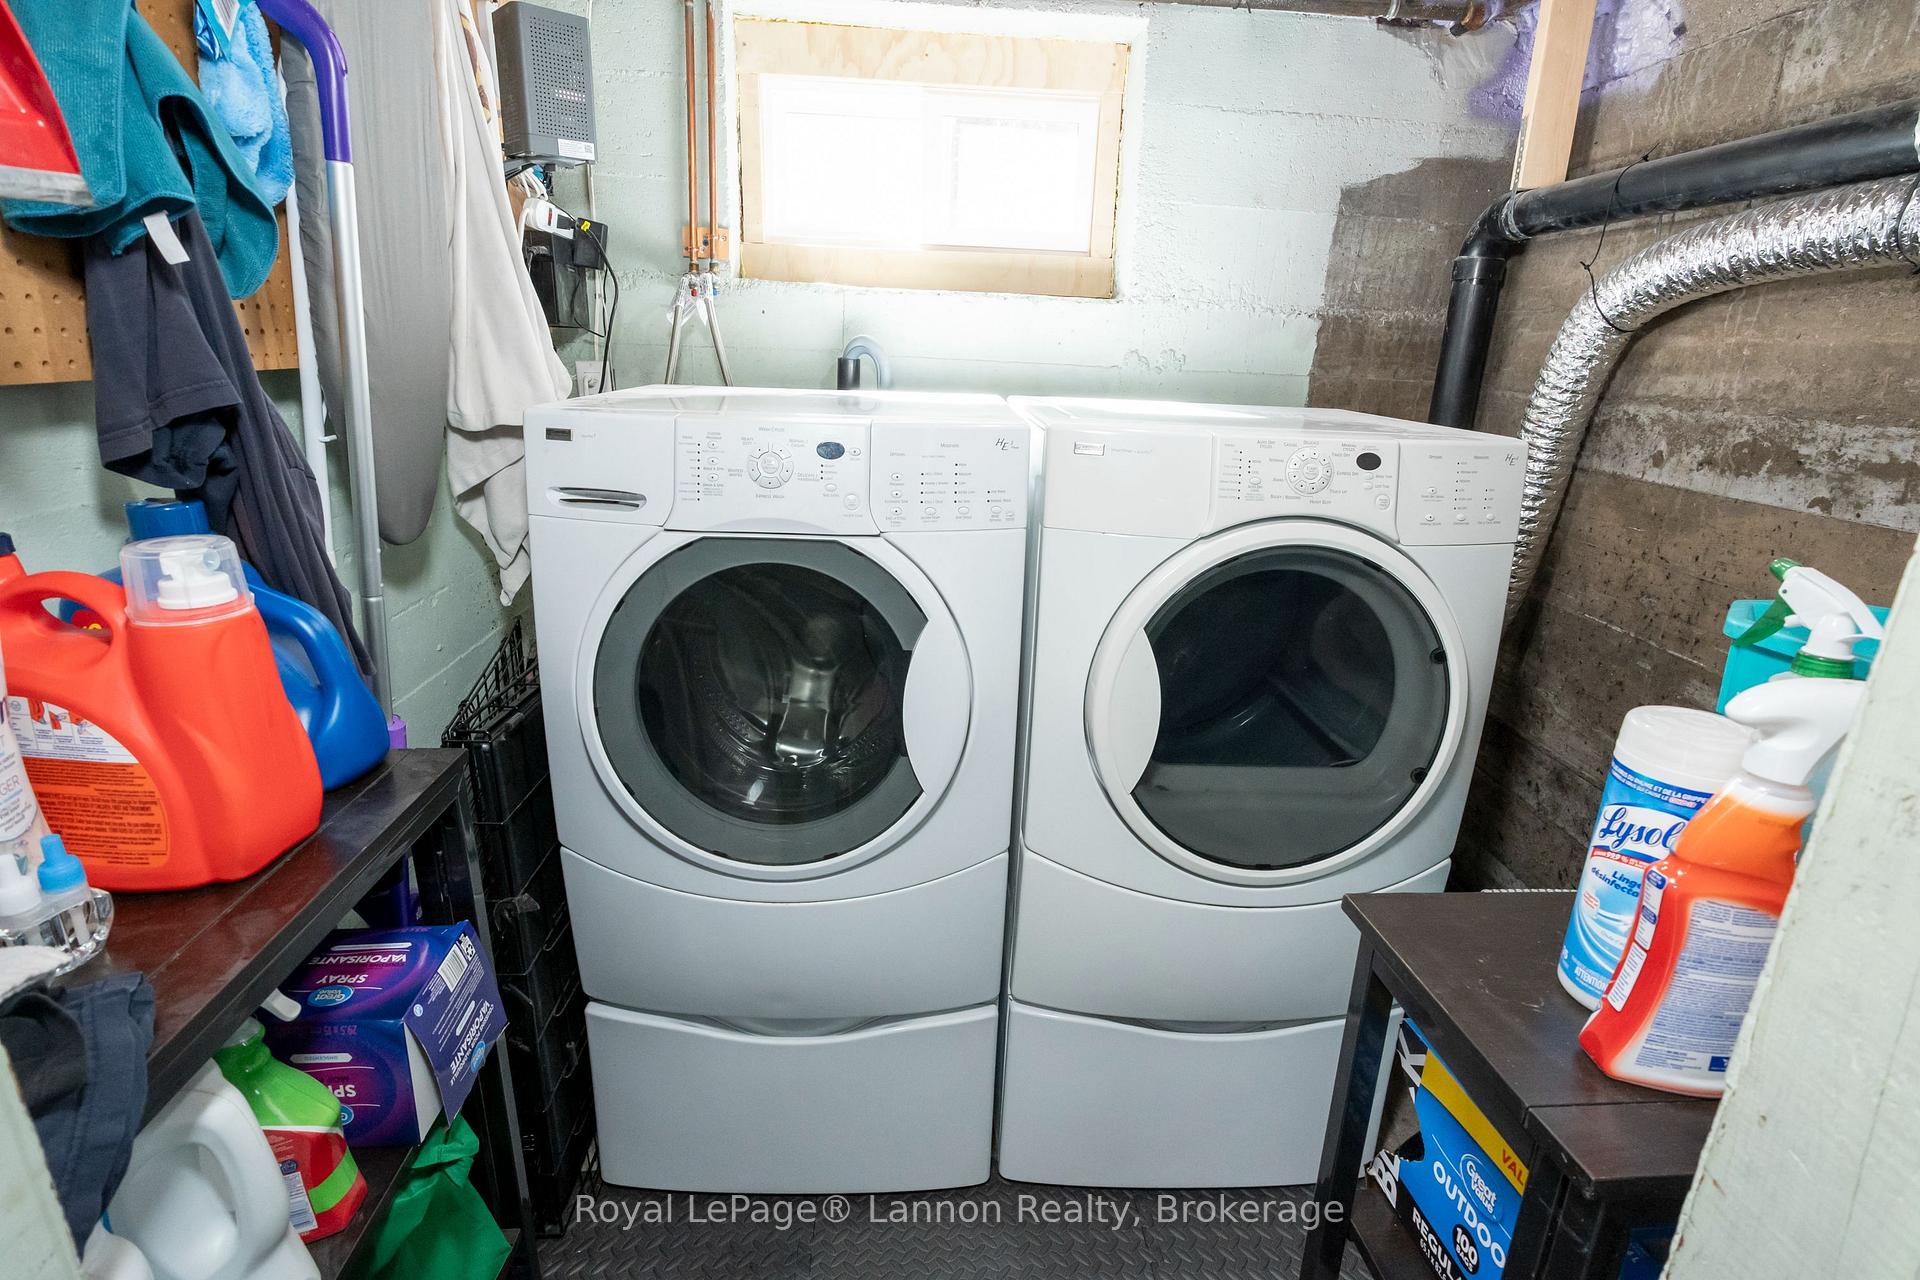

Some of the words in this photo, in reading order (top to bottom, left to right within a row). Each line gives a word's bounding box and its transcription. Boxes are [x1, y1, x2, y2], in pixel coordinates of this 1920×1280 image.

[1598, 806, 1686, 850] Lysol
[307, 953, 407, 965] VAPORISANTE
[315, 974, 369, 984] SPRAY
[450, 1000, 490, 1074] VAPORISANTE
[1466, 1160, 1497, 1206] Great
[1501, 1149, 1525, 1186] VAL
[1433, 1160, 1506, 1269] OUTDOO
[1471, 1179, 1494, 1214] Value
[1412, 1206, 1462, 1280] REGUL
[1455, 1243, 1474, 1272] BAGS
[1456, 1226, 1478, 1266] 100
